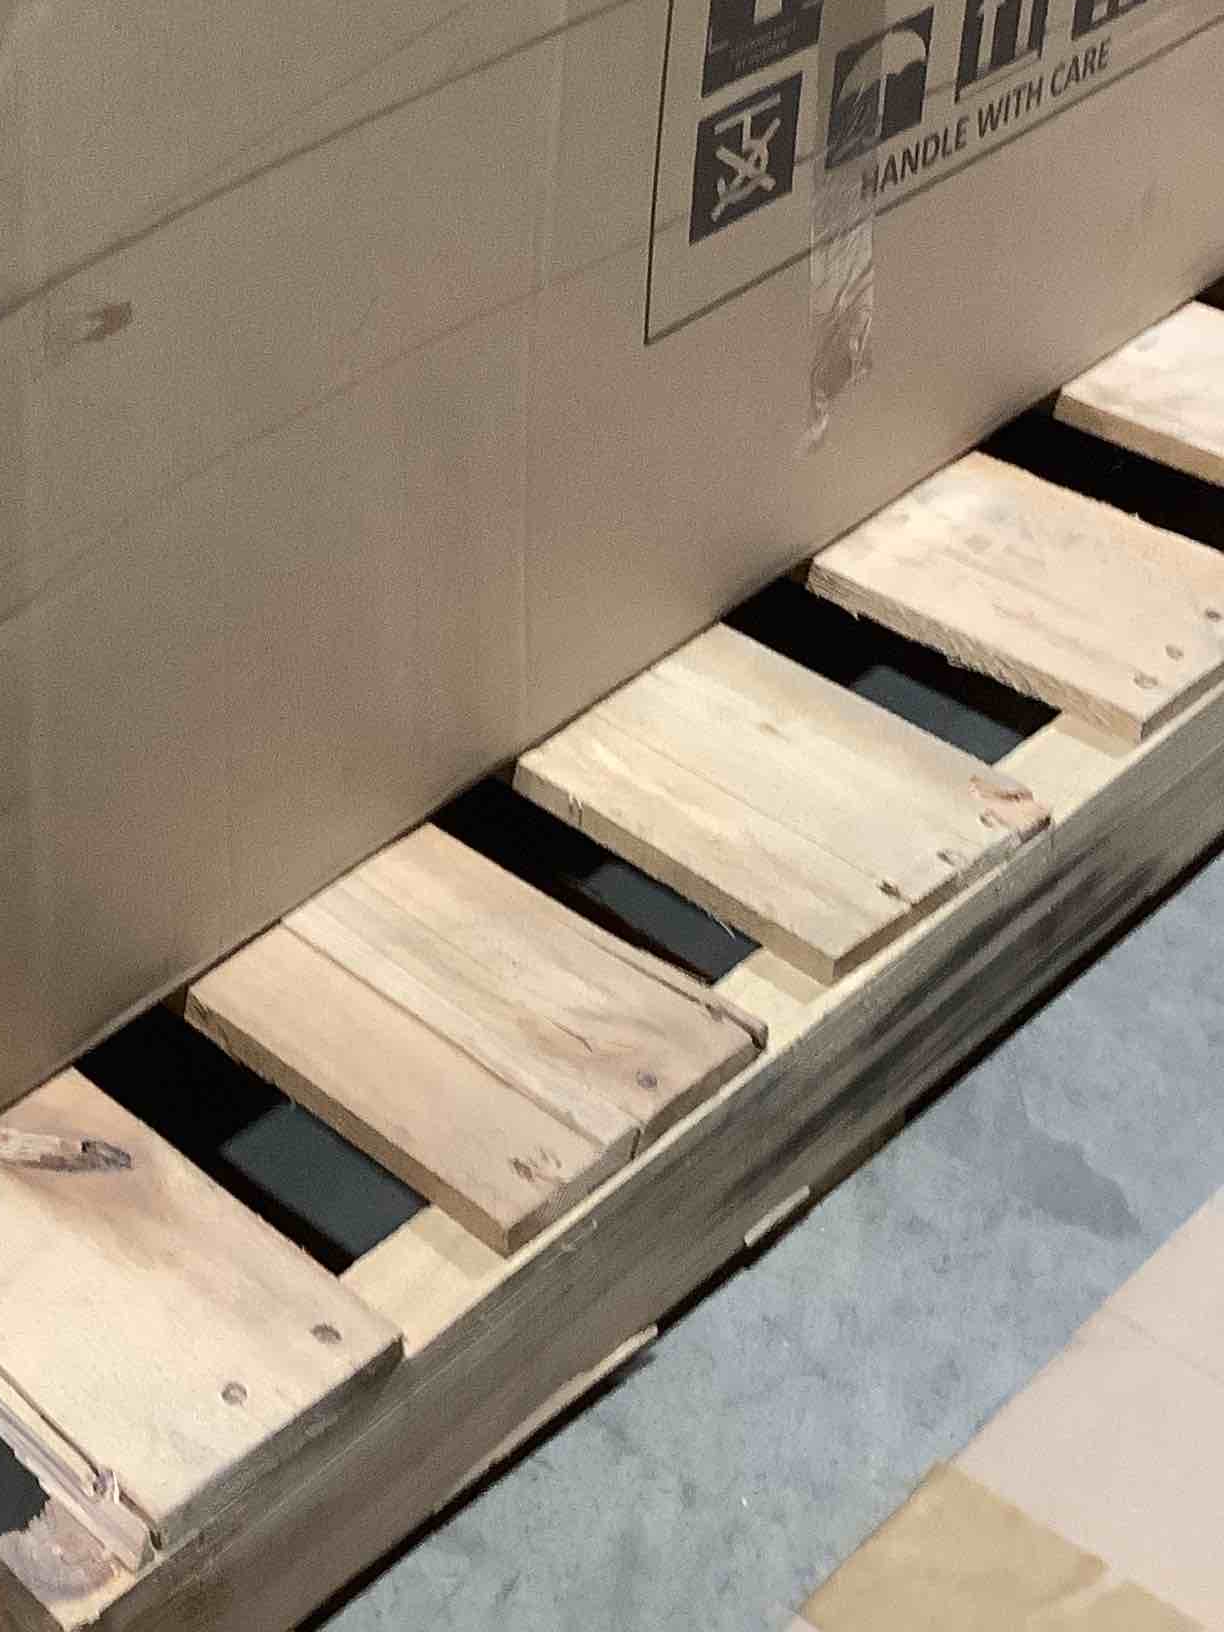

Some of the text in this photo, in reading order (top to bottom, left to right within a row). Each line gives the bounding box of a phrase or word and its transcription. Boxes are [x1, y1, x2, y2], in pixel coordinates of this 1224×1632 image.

[860, 38, 1112, 202] HANDLE WITH CARE
